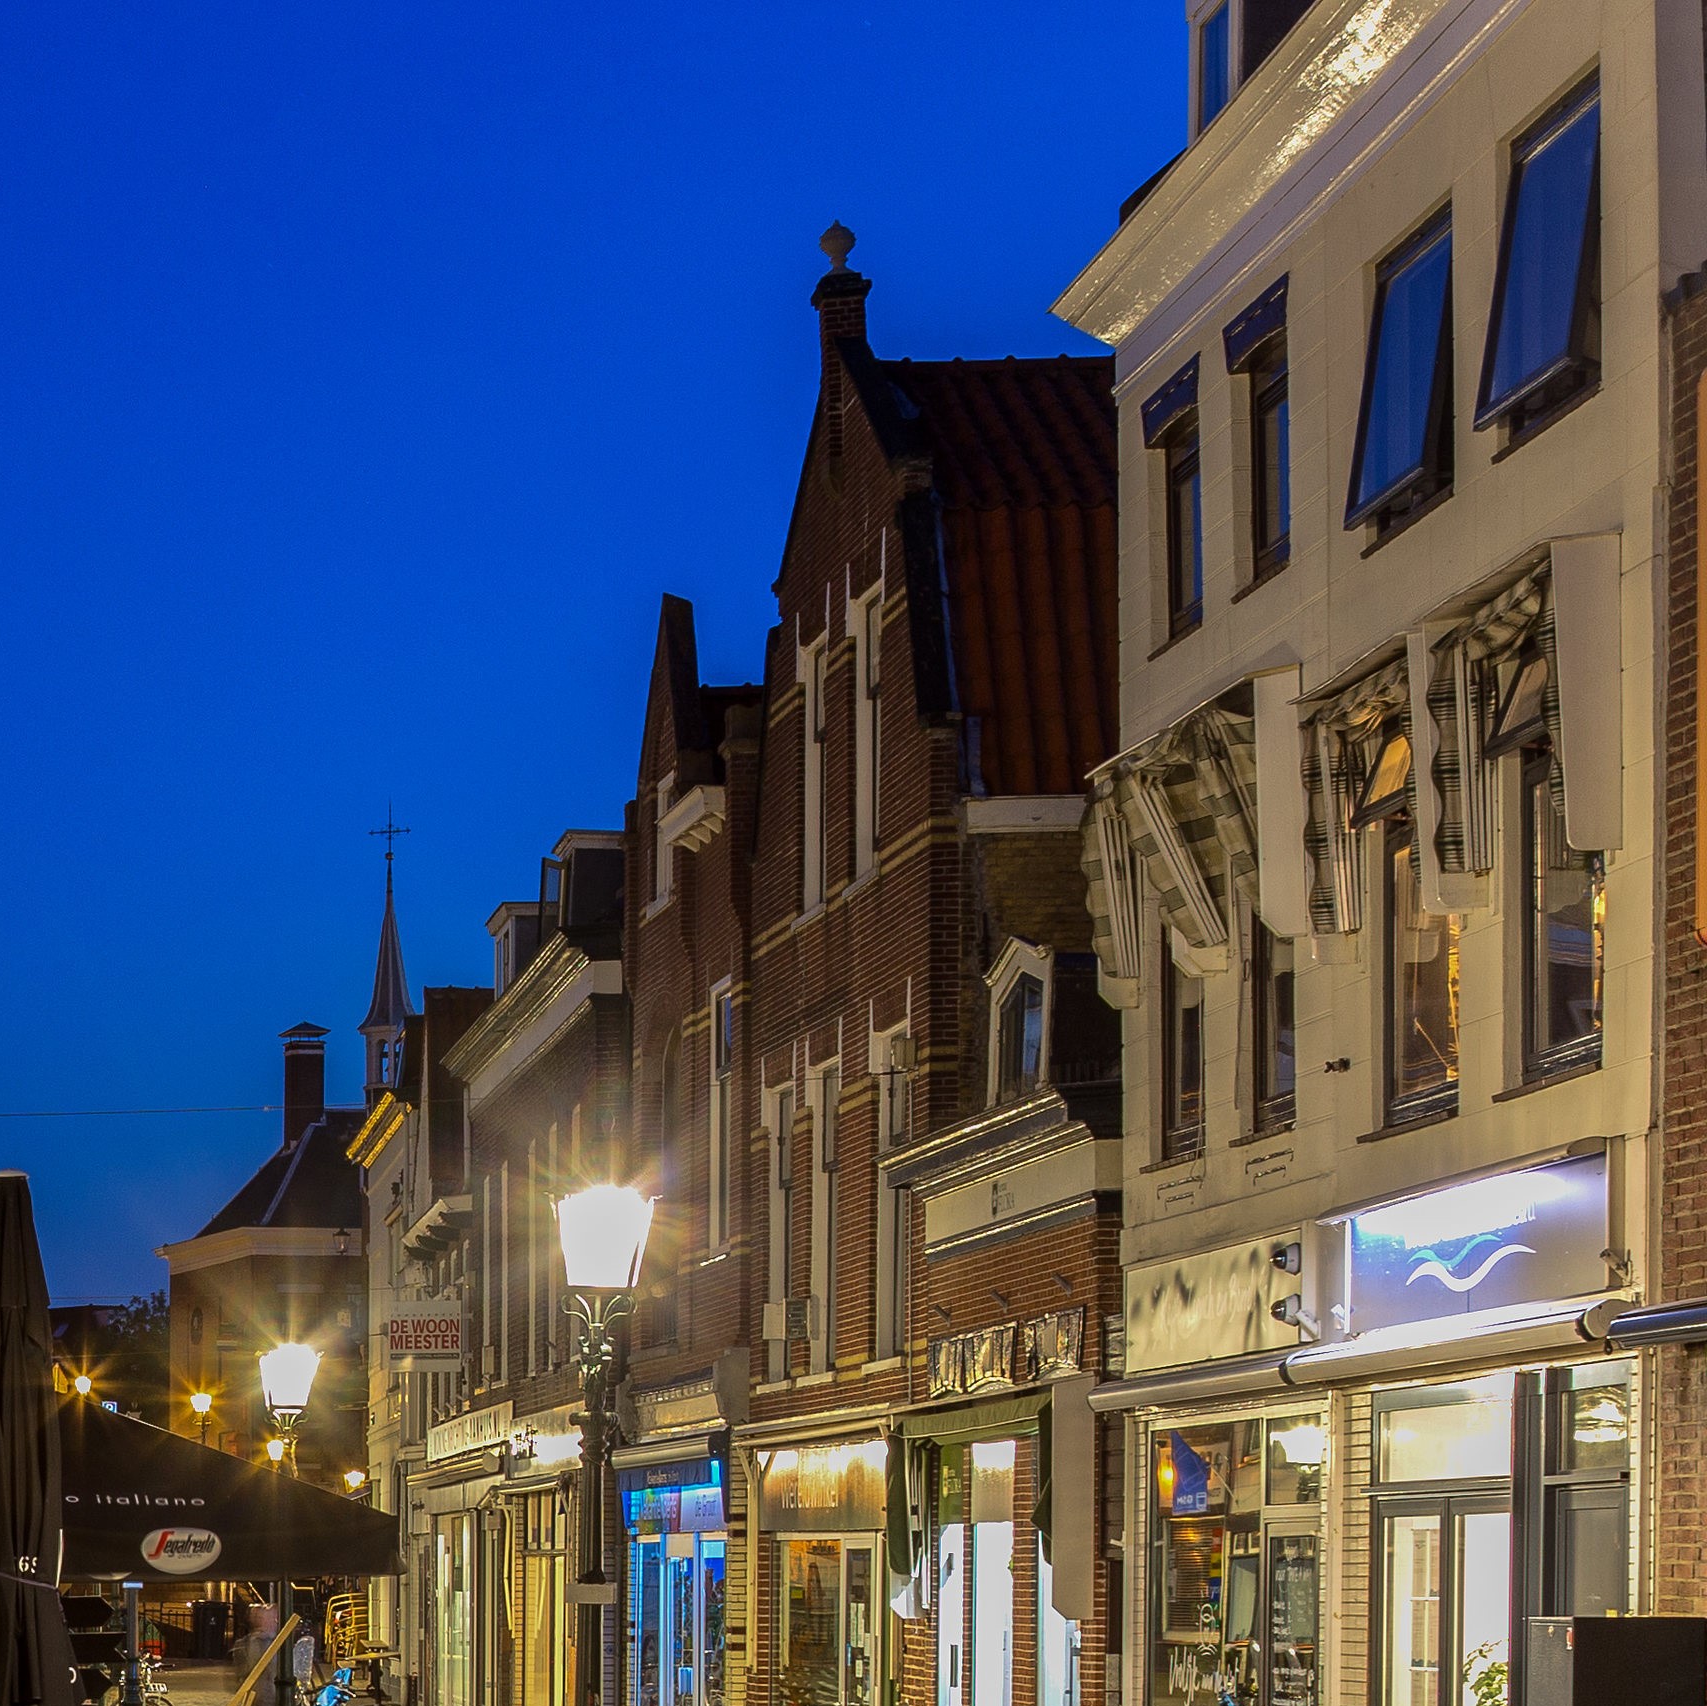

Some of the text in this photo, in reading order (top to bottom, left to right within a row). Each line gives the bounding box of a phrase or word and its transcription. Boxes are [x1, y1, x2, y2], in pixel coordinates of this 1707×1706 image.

[390, 1318, 460, 1334] DE WOON
[390, 1334, 460, 1350] MEESTER
[96, 1494, 206, 1507] italiano
[148, 1530, 216, 1560] Segafredo
